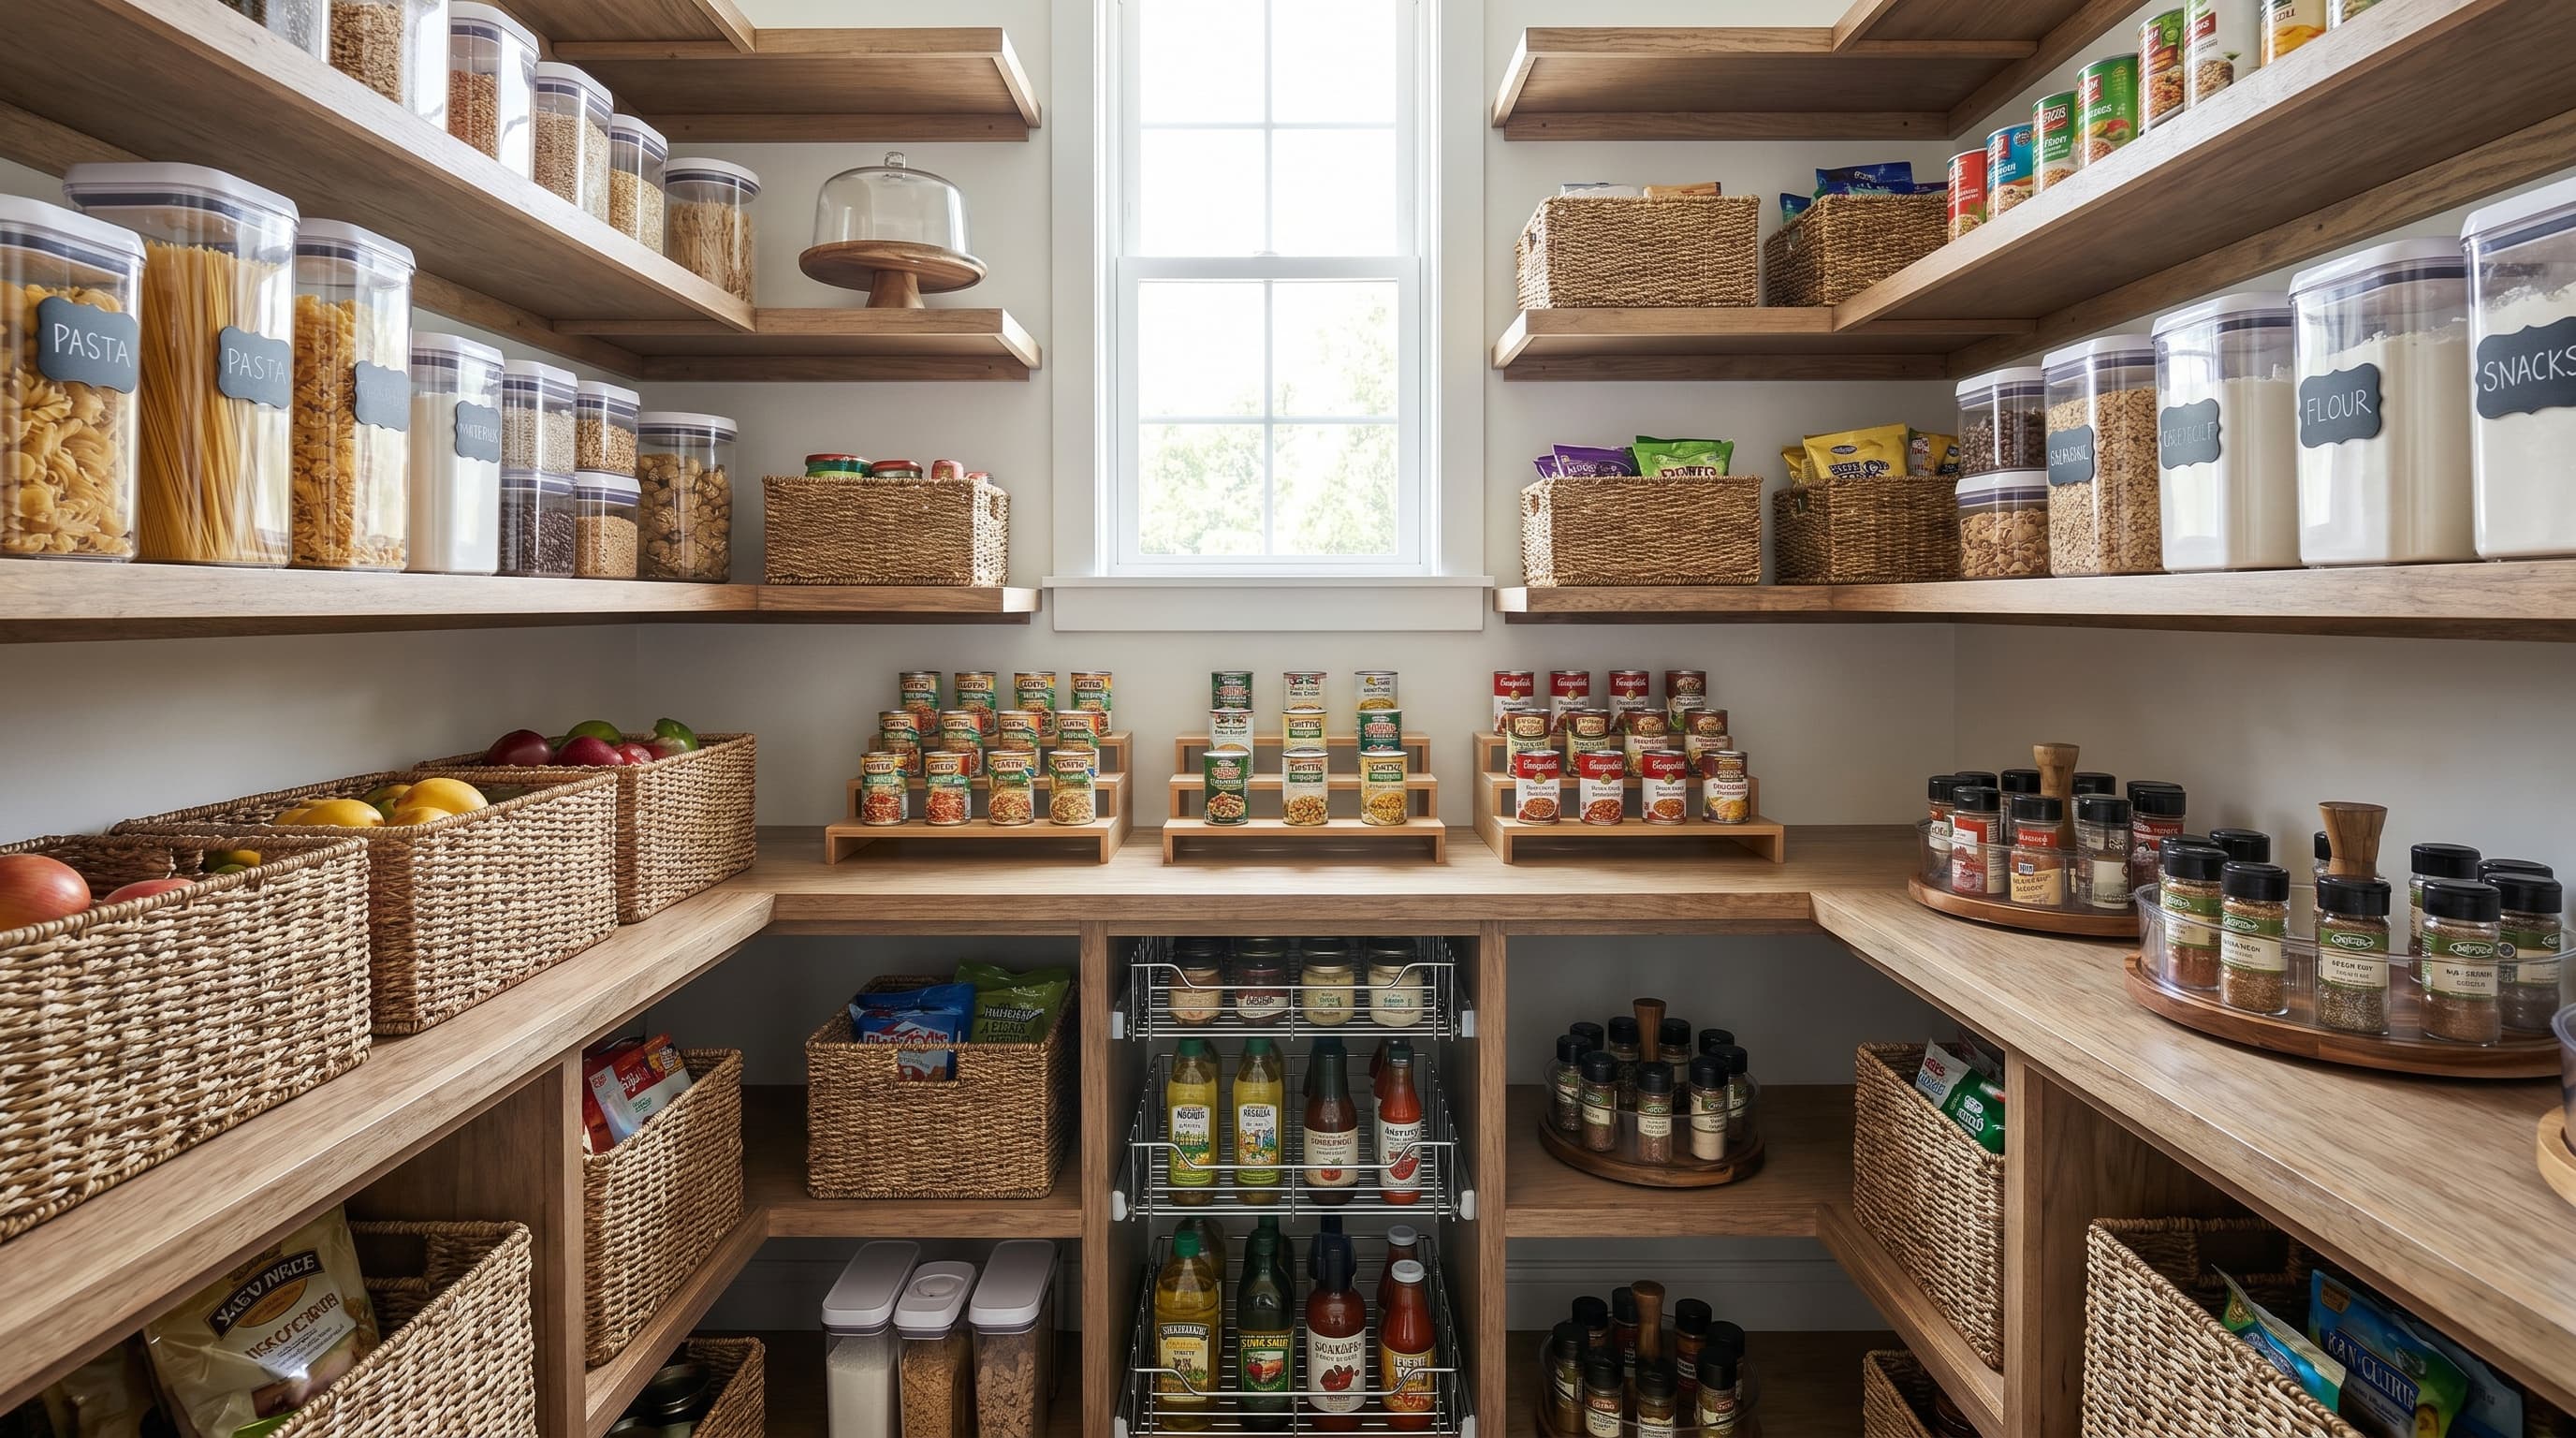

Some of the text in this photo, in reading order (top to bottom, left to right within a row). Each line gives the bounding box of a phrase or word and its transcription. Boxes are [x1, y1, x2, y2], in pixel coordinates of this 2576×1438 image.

[54, 323, 131, 368] PASTA
[227, 347, 286, 385] PASTA
[2483, 345, 2576, 392] SNACKS
[2307, 389, 2372, 426] FLOUR
